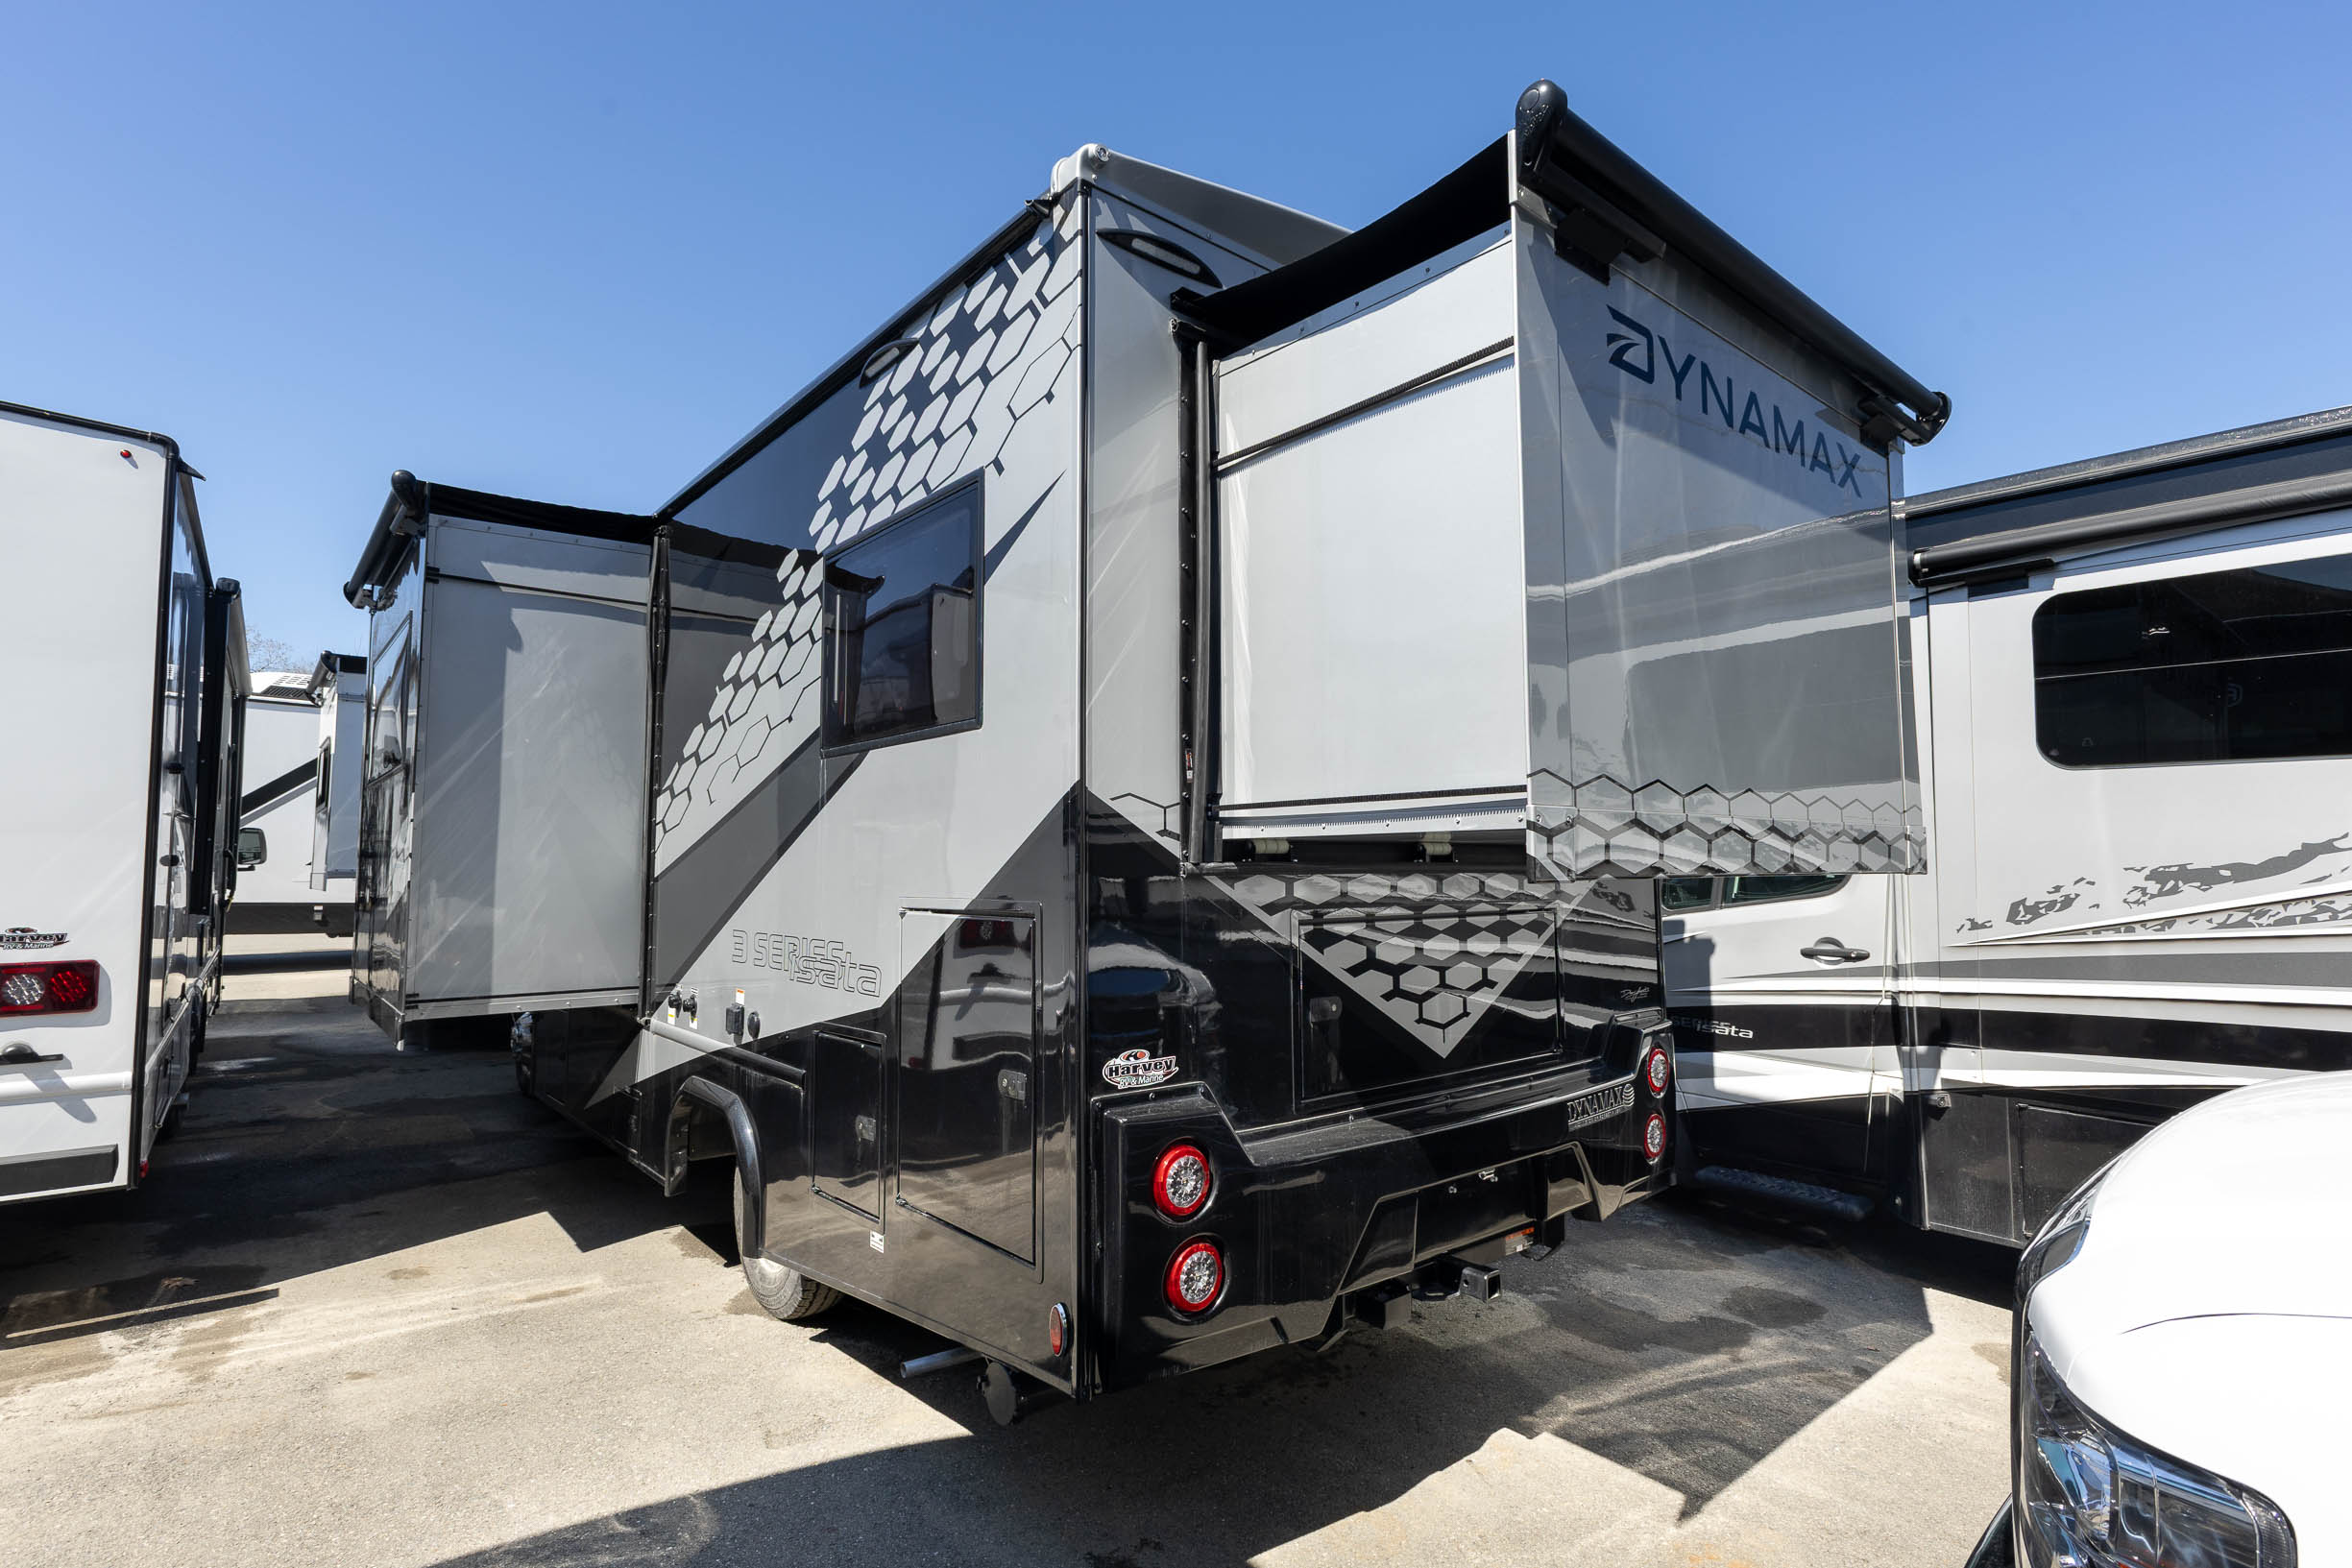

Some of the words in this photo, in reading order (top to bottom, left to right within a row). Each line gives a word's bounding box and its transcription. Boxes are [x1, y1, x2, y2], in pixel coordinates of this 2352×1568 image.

[1606, 303, 1862, 498] DYNAMAX
[1107, 1058, 1176, 1077] Harvey
[1138, 1073, 1164, 1085] Marine
[1566, 1086, 1623, 1122] DYNAMAX
